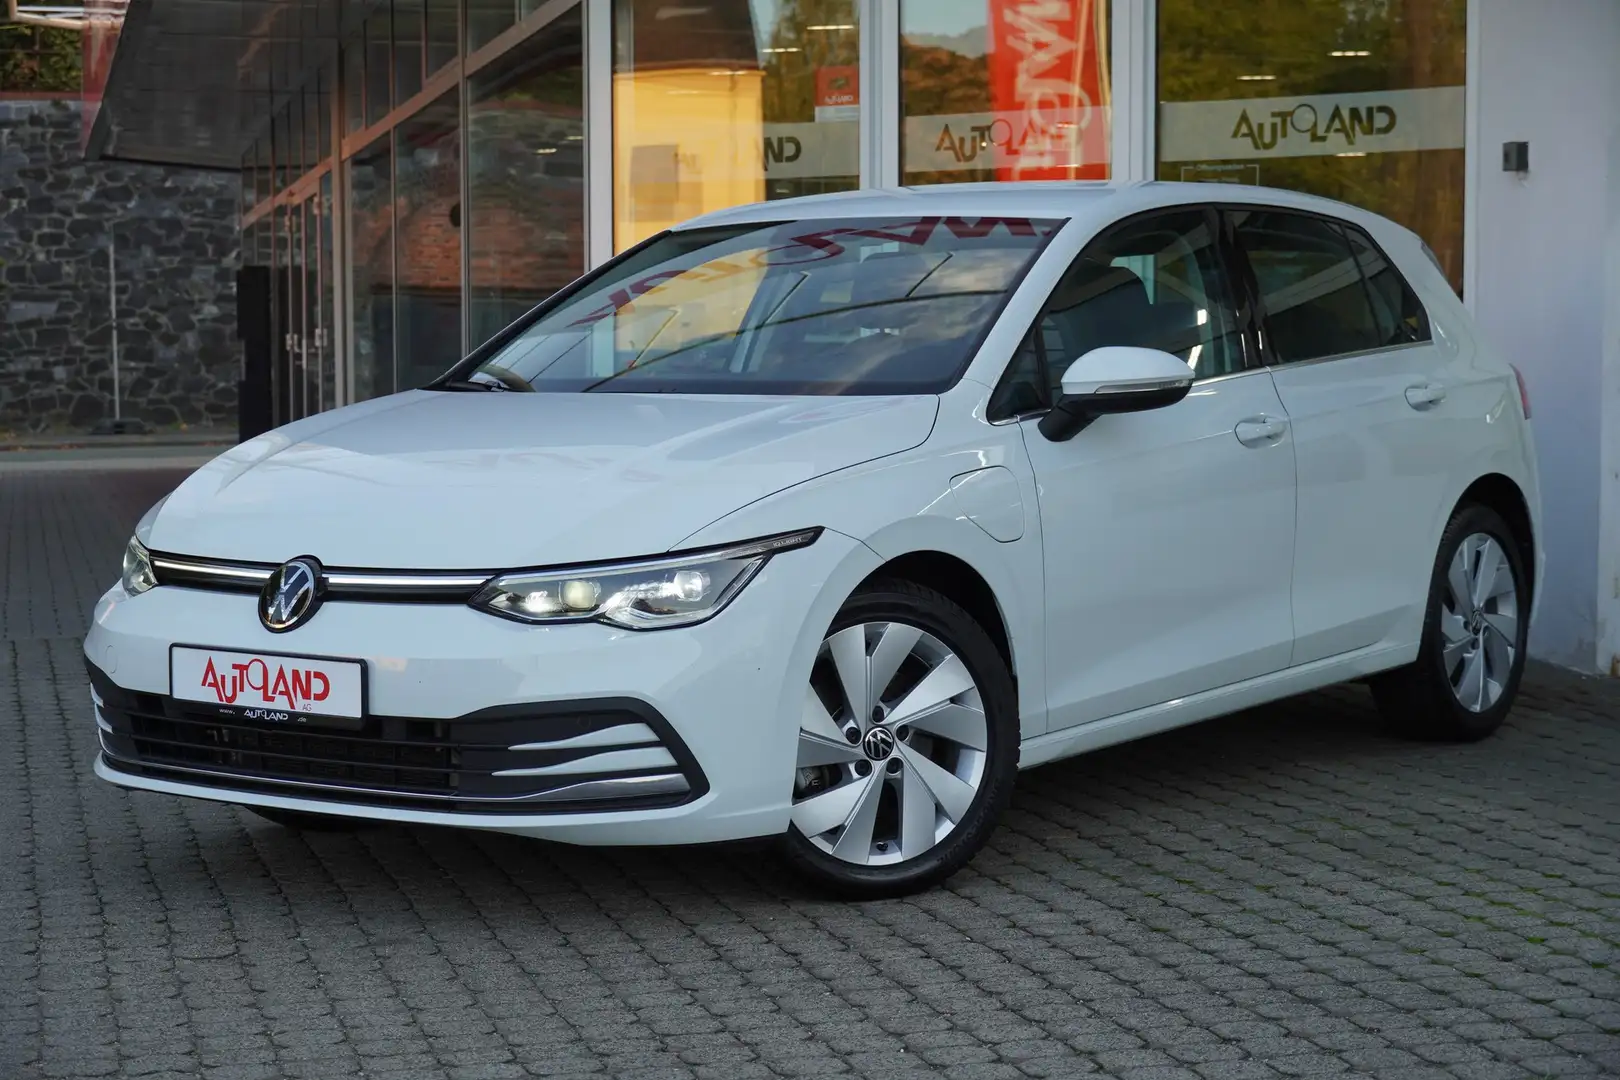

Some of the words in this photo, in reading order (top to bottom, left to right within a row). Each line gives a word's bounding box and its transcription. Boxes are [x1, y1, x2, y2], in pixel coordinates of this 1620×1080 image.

[1231, 103, 1396, 150] AUTOLAND
[201, 656, 331, 710] AUTOLAND
[244, 708, 289, 721] AUTOLAND
[302, 703, 312, 712] AG
